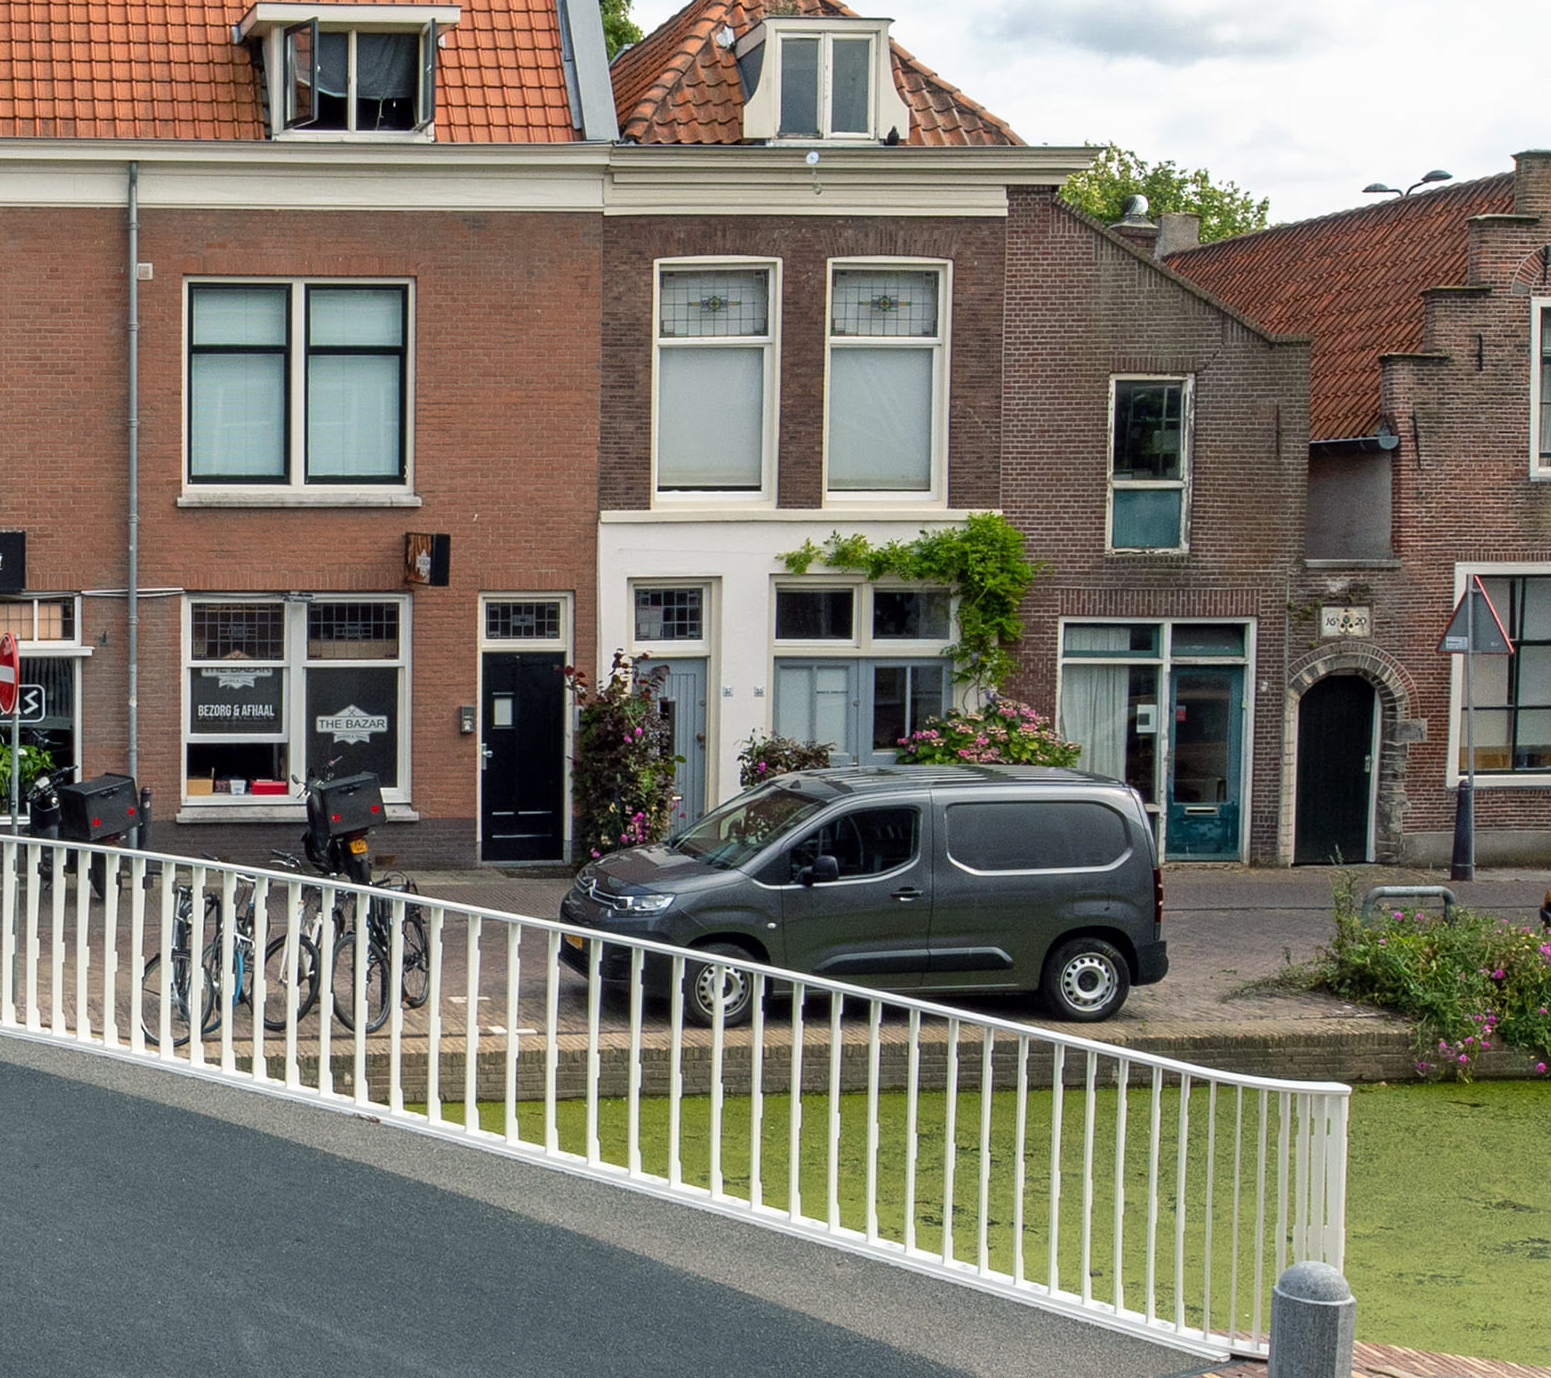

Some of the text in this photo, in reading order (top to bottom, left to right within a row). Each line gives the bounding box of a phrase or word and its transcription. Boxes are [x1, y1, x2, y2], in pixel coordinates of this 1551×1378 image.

[198, 704, 275, 717] BEZORG & AFHAAL
[319, 718, 386, 730] THE BAZAR
